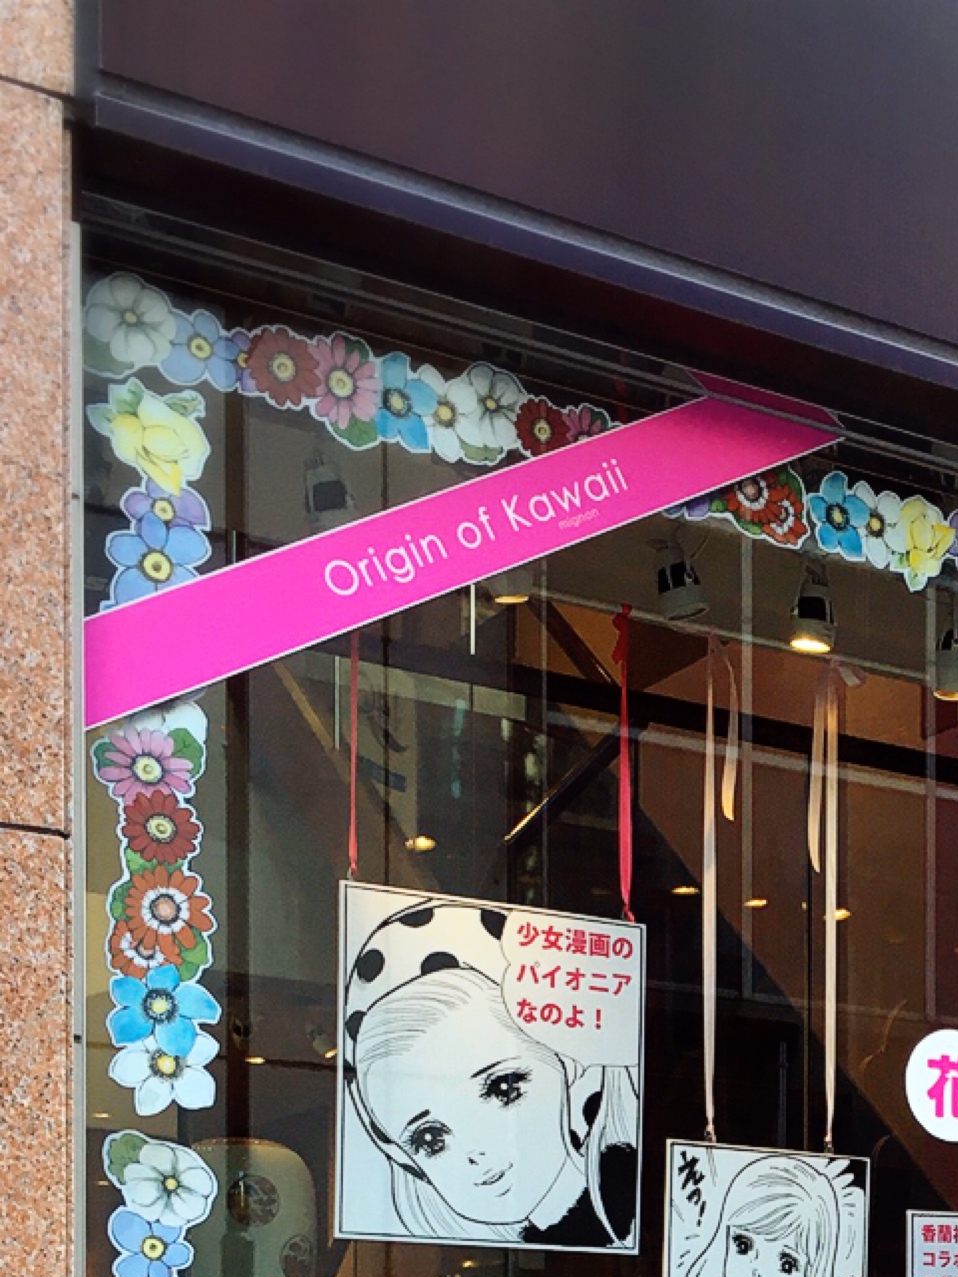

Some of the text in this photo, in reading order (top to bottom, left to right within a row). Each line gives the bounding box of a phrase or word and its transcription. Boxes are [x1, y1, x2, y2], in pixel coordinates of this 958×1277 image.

[324, 458, 629, 595] Origin of Kawaii
[517, 921, 633, 959] 少女漫画の
[517, 961, 632, 996] パイオニア
[517, 998, 602, 1030] なのよ!
